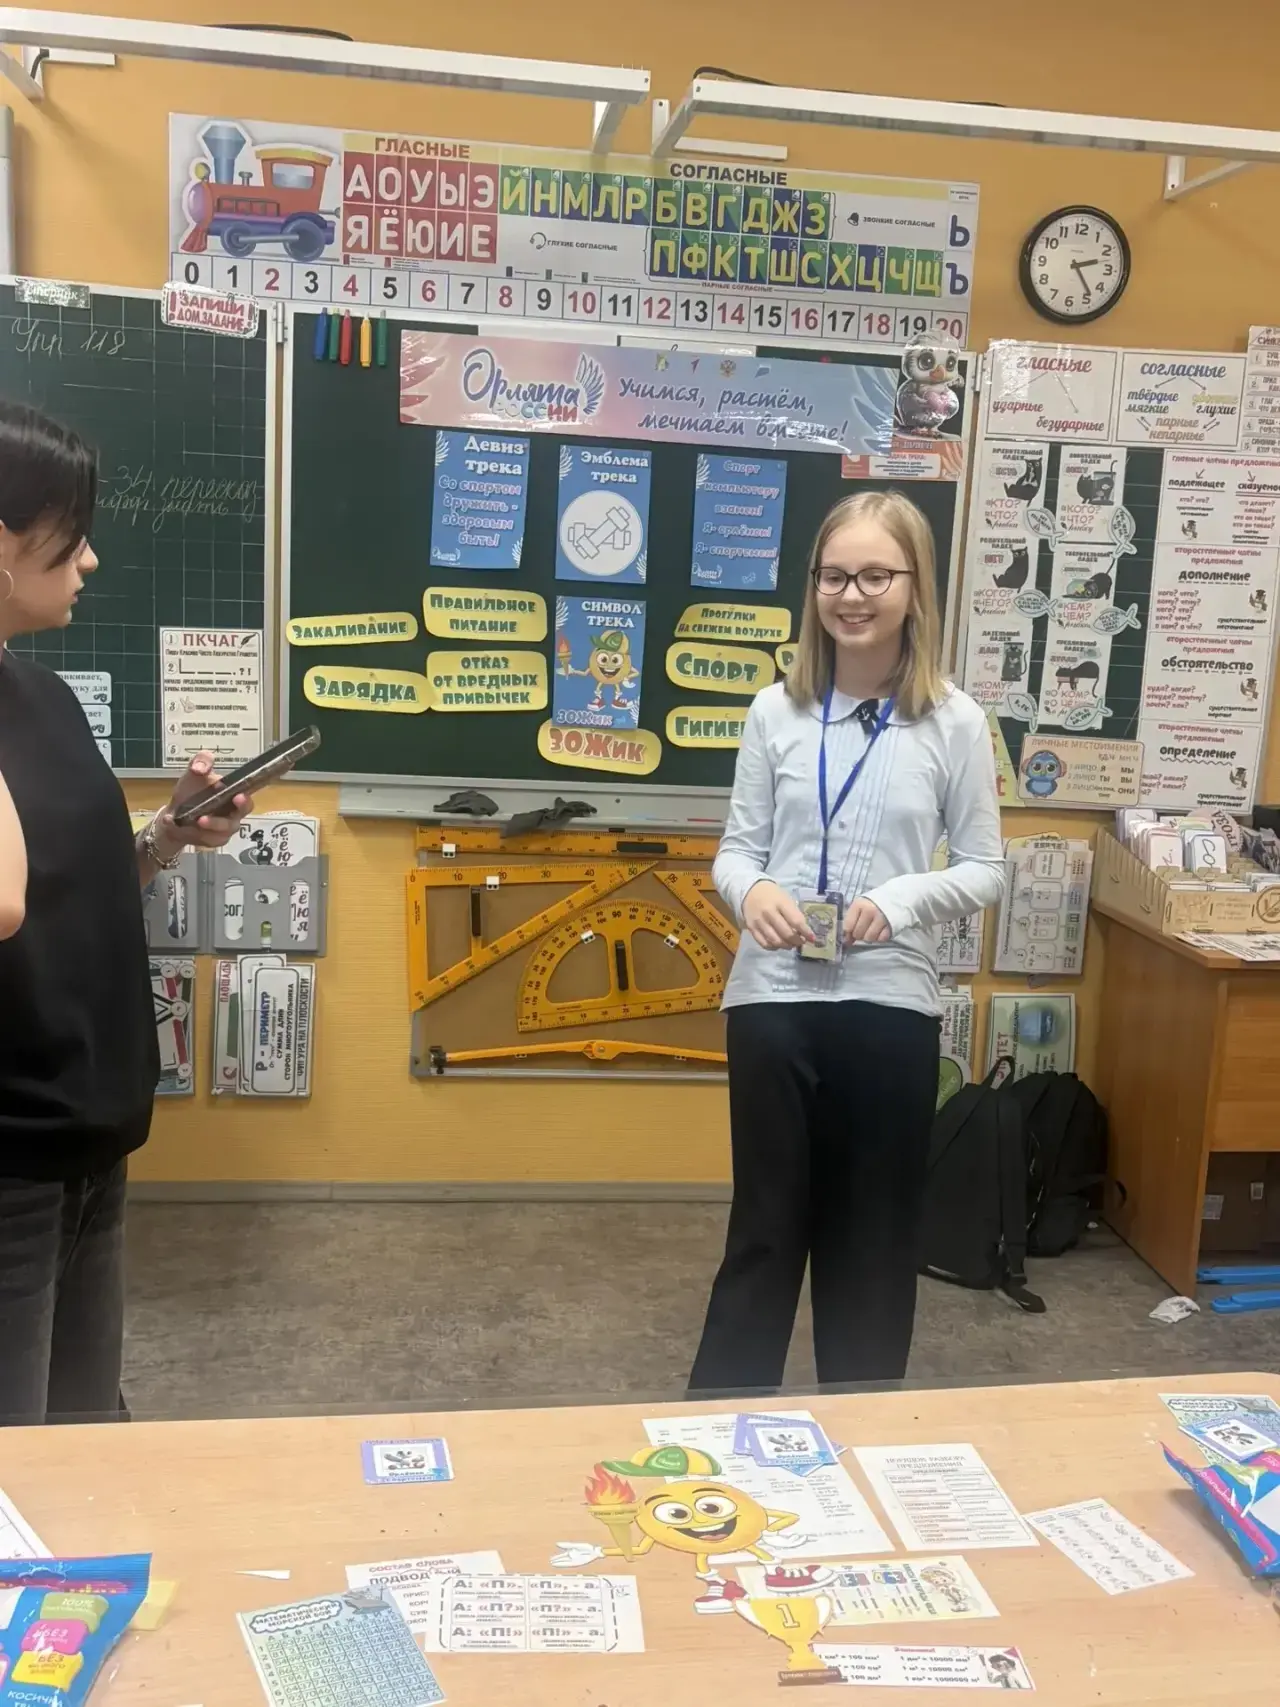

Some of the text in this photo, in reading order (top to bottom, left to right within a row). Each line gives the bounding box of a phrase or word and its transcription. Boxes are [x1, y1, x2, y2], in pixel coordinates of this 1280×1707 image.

[375, 137, 470, 159] ГЛАСНЫЕ
[670, 163, 787, 186] СОГЛАСНЫЕ
[1060, 226, 1068, 238] 11
[1075, 223, 1089, 235] 12
[1045, 237, 1059, 249] 10
[1095, 231, 1100, 243] 1
[1102, 244, 1112, 256] 2
[1038, 255, 1047, 267] 9
[1103, 264, 1113, 276] 3
[1039, 274, 1049, 285] 8
[1050, 288, 1059, 300] 7
[1095, 282, 1105, 293] 4
[180, 292, 245, 316] ЗАПИШИ
[184, 262, 927, 337] 0 1 2 3 4 5 6 7 8 9 10 11 12 13 14 15 16 17 18 19
[1065, 296, 1074, 307] 6
[1082, 293, 1091, 304] 5
[1017, 356, 1092, 374] гласные
[1140, 362, 1227, 379] согласные
[463, 348, 581, 409] Орлята
[618, 377, 814, 415] Учимся, растём,
[1127, 389, 1179, 403] твёрдые
[992, 400, 1044, 416] ударные
[1125, 403, 1237, 417] мягкие глухие
[637, 411, 745, 436] мечтаем
[1036, 416, 1105, 433] безударные
[1155, 416, 1199, 429] парные
[1149, 428, 1206, 442] непарные
[464, 435, 525, 456] Девиз
[464, 457, 523, 476] трека
[580, 451, 649, 468] Эмблема
[723, 460, 761, 477] Спорт
[590, 470, 637, 484] трека
[1168, 479, 1226, 489] подлежащее
[438, 474, 522, 497] Со спортом
[704, 482, 780, 500] компьютеру
[441, 511, 514, 531] здоровым
[458, 531, 500, 547] быть!
[1178, 569, 1251, 582] дополнение
[581, 600, 642, 615] СИМВОЛ
[449, 618, 518, 634] ПИТАНИЕ
[586, 616, 635, 629] ТРЕКА
[692, 623, 732, 634] СВЕЖЕМ
[183, 633, 239, 648] ПКЧАГ
[167, 663, 174, 672] 2
[461, 656, 510, 670] ОТКАЗ
[1161, 656, 1254, 672] обстоятельство
[433, 674, 538, 689] ОТ ВРЕДНЫХ
[442, 692, 531, 705] ПРИВЫЧЕК
[169, 702, 176, 711] 3
[169, 724, 175, 733] 4
[675, 716, 747, 737] ГИГИЕ
[1031, 738, 1139, 752] ЛИЧНЫЕ МЕСТОИМЕНИЯ
[1159, 746, 1237, 760] определение
[453, 872, 463, 882] 10
[584, 868, 595, 878] 40
[612, 910, 622, 918] 90
[219, 962, 231, 1003] ПЛОЩАДЬ
[259, 991, 271, 1046] ПЕРИМЕТР
[285, 983, 295, 1050] МНОГОУГОЛЬНИКА
[276, 1031, 284, 1059] СУММА
[368, 1558, 454, 1573] СОСТАВ СЛОВА
[255, 1602, 339, 1625] МАТЕМАТИЧЕСКИЙ
[268, 1612, 312, 1628] МОРСКОЙ
[775, 1603, 800, 1629] 1
